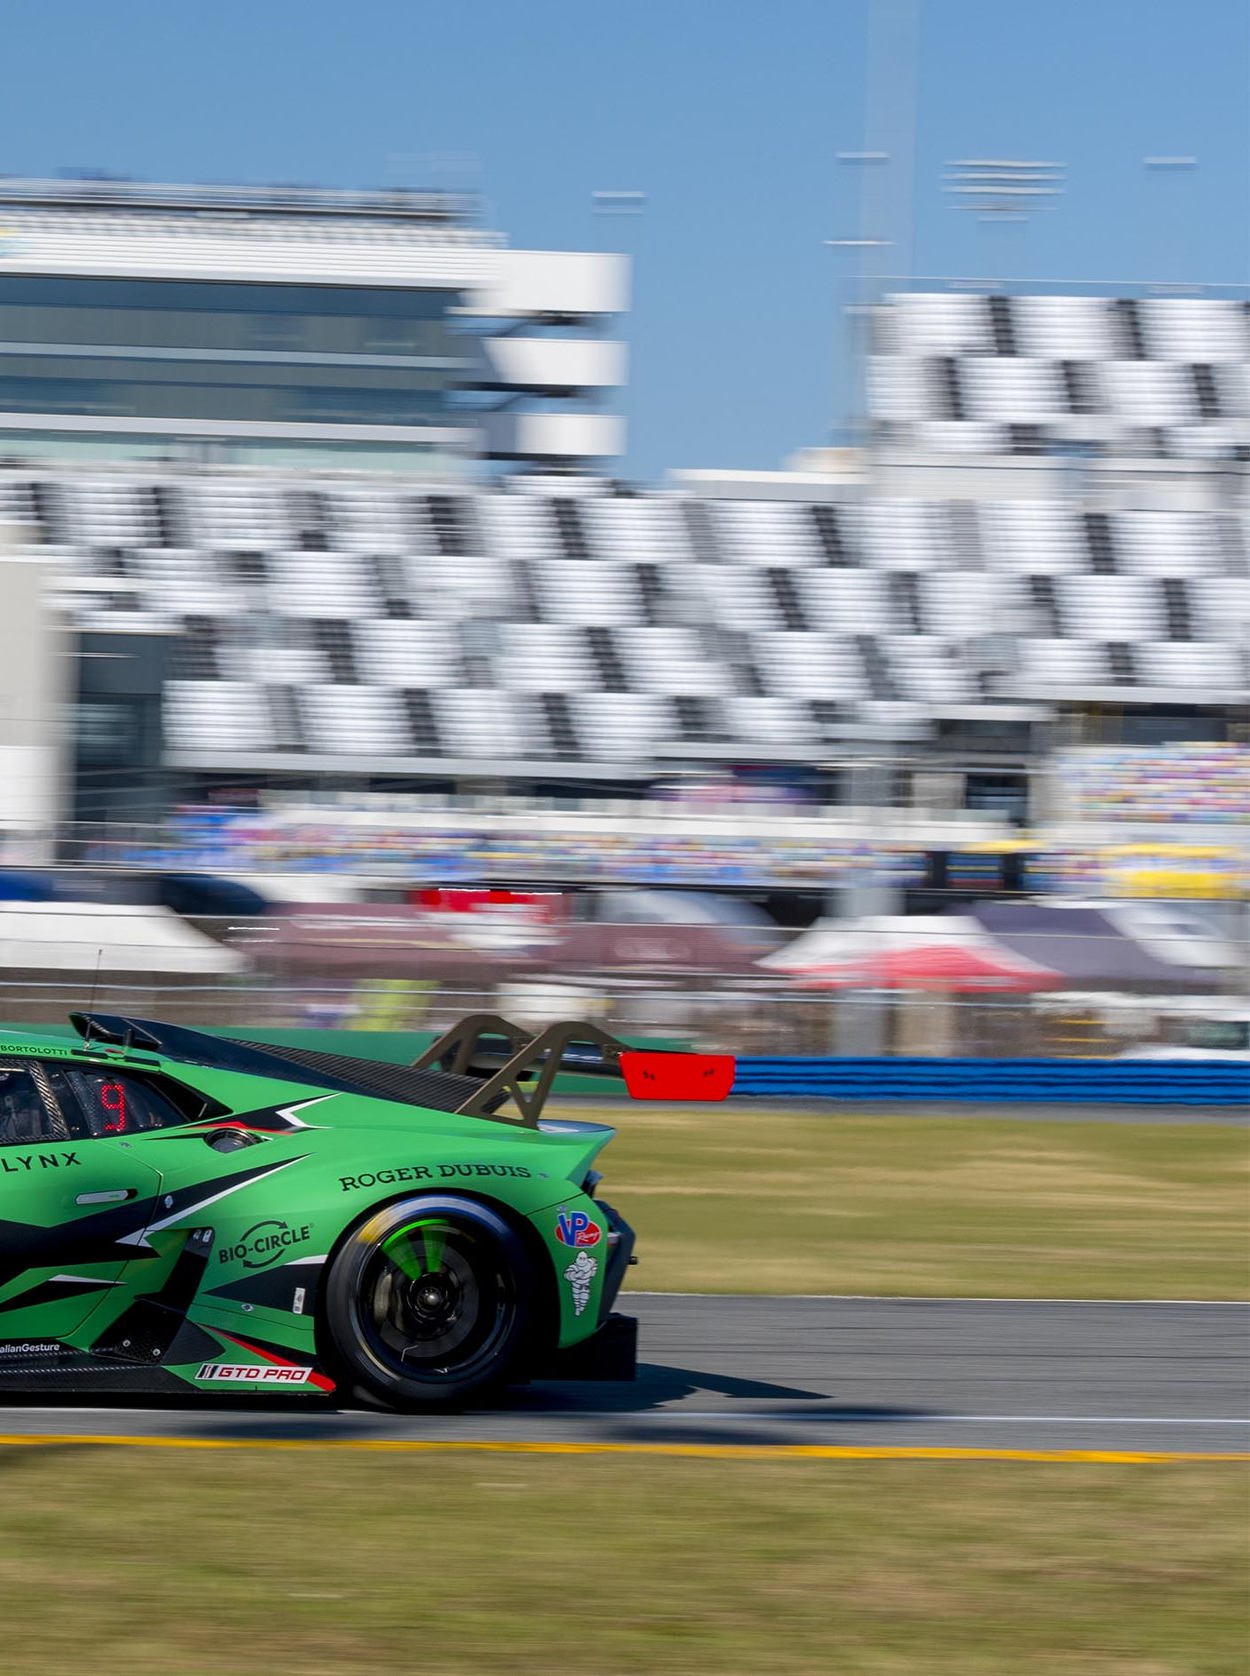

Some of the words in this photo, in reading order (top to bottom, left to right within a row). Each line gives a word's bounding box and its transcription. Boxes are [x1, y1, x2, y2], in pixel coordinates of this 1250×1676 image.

[1, 1044, 68, 1056] BORTOLOTTI
[101, 1083, 126, 1131] 9
[0, 1152, 82, 1173] LYNX
[339, 1166, 433, 1191] ROGER
[437, 1164, 531, 1178] DUBUIS
[558, 1211, 589, 1247] VP
[219, 1226, 310, 1264] BIO-CIRCLE
[218, 1367, 260, 1378] GTD
[263, 1369, 306, 1380] PRO
